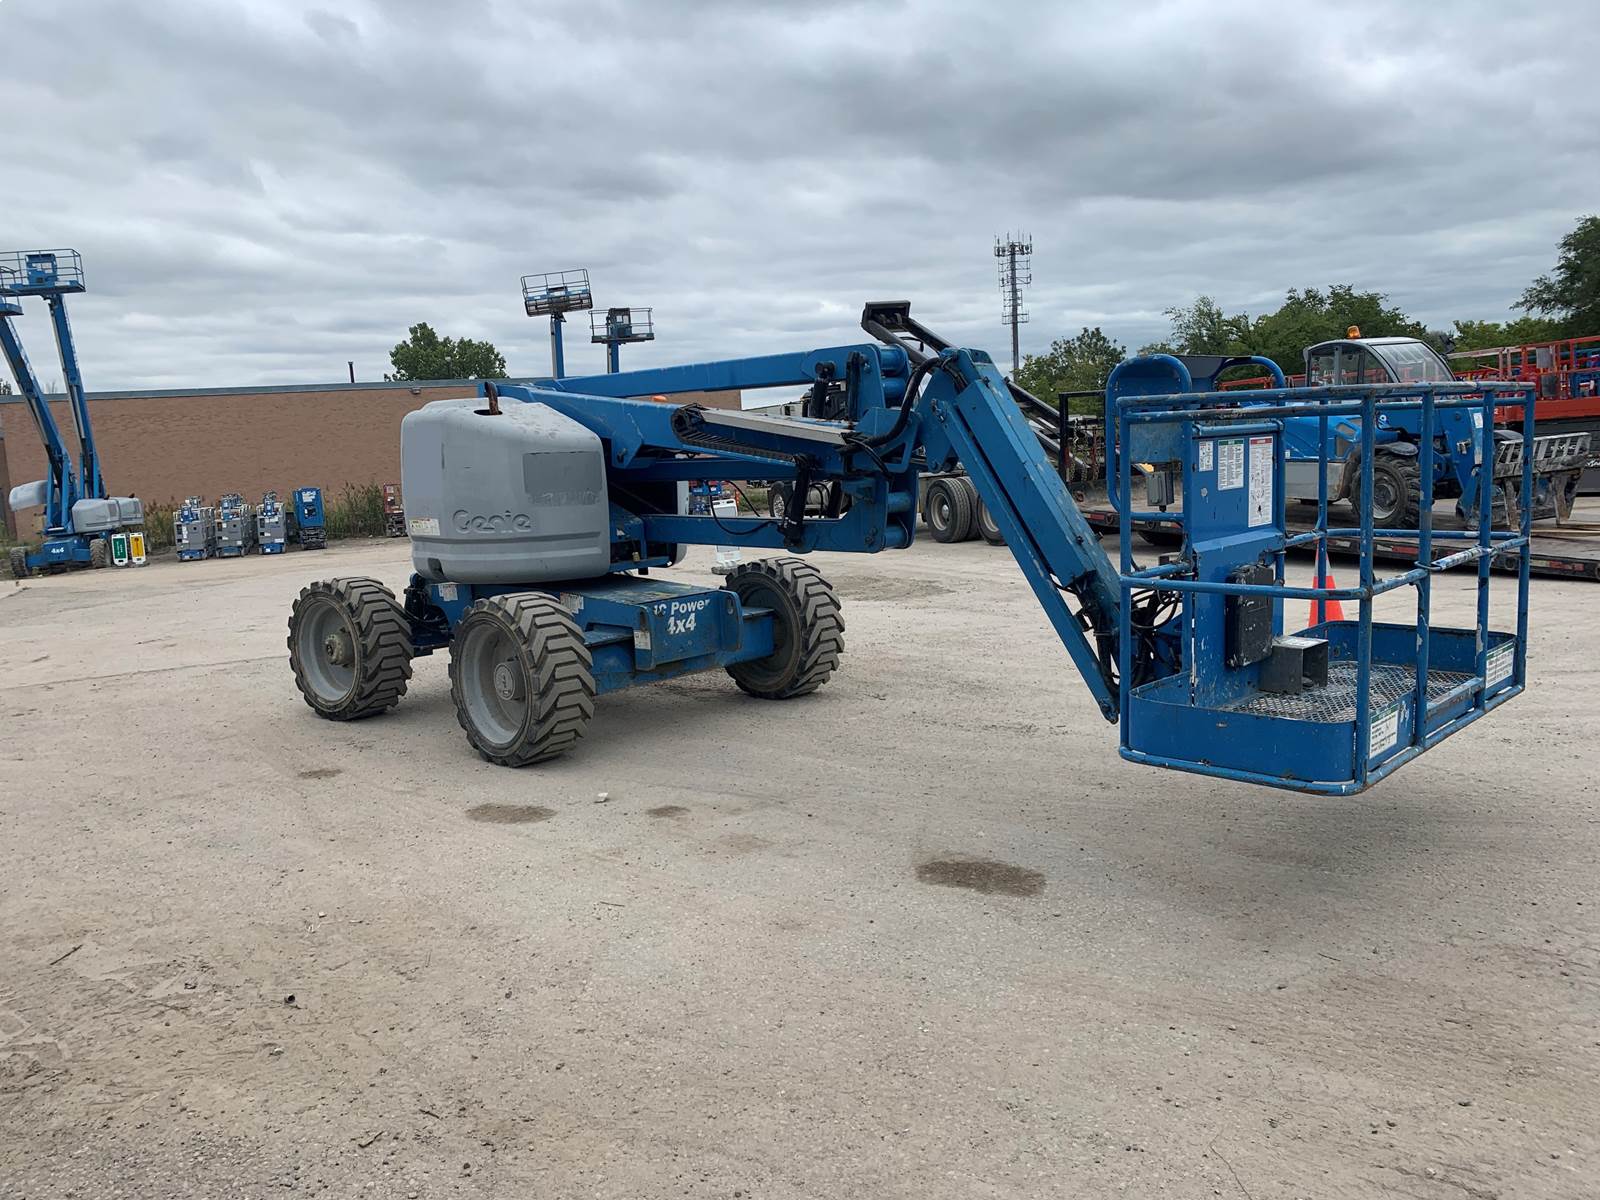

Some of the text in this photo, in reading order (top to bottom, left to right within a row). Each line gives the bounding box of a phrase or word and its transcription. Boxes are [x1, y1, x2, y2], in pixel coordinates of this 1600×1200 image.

[452, 509, 533, 534] Genie
[671, 599, 710, 615] Power
[667, 612, 696, 634] 4x4
